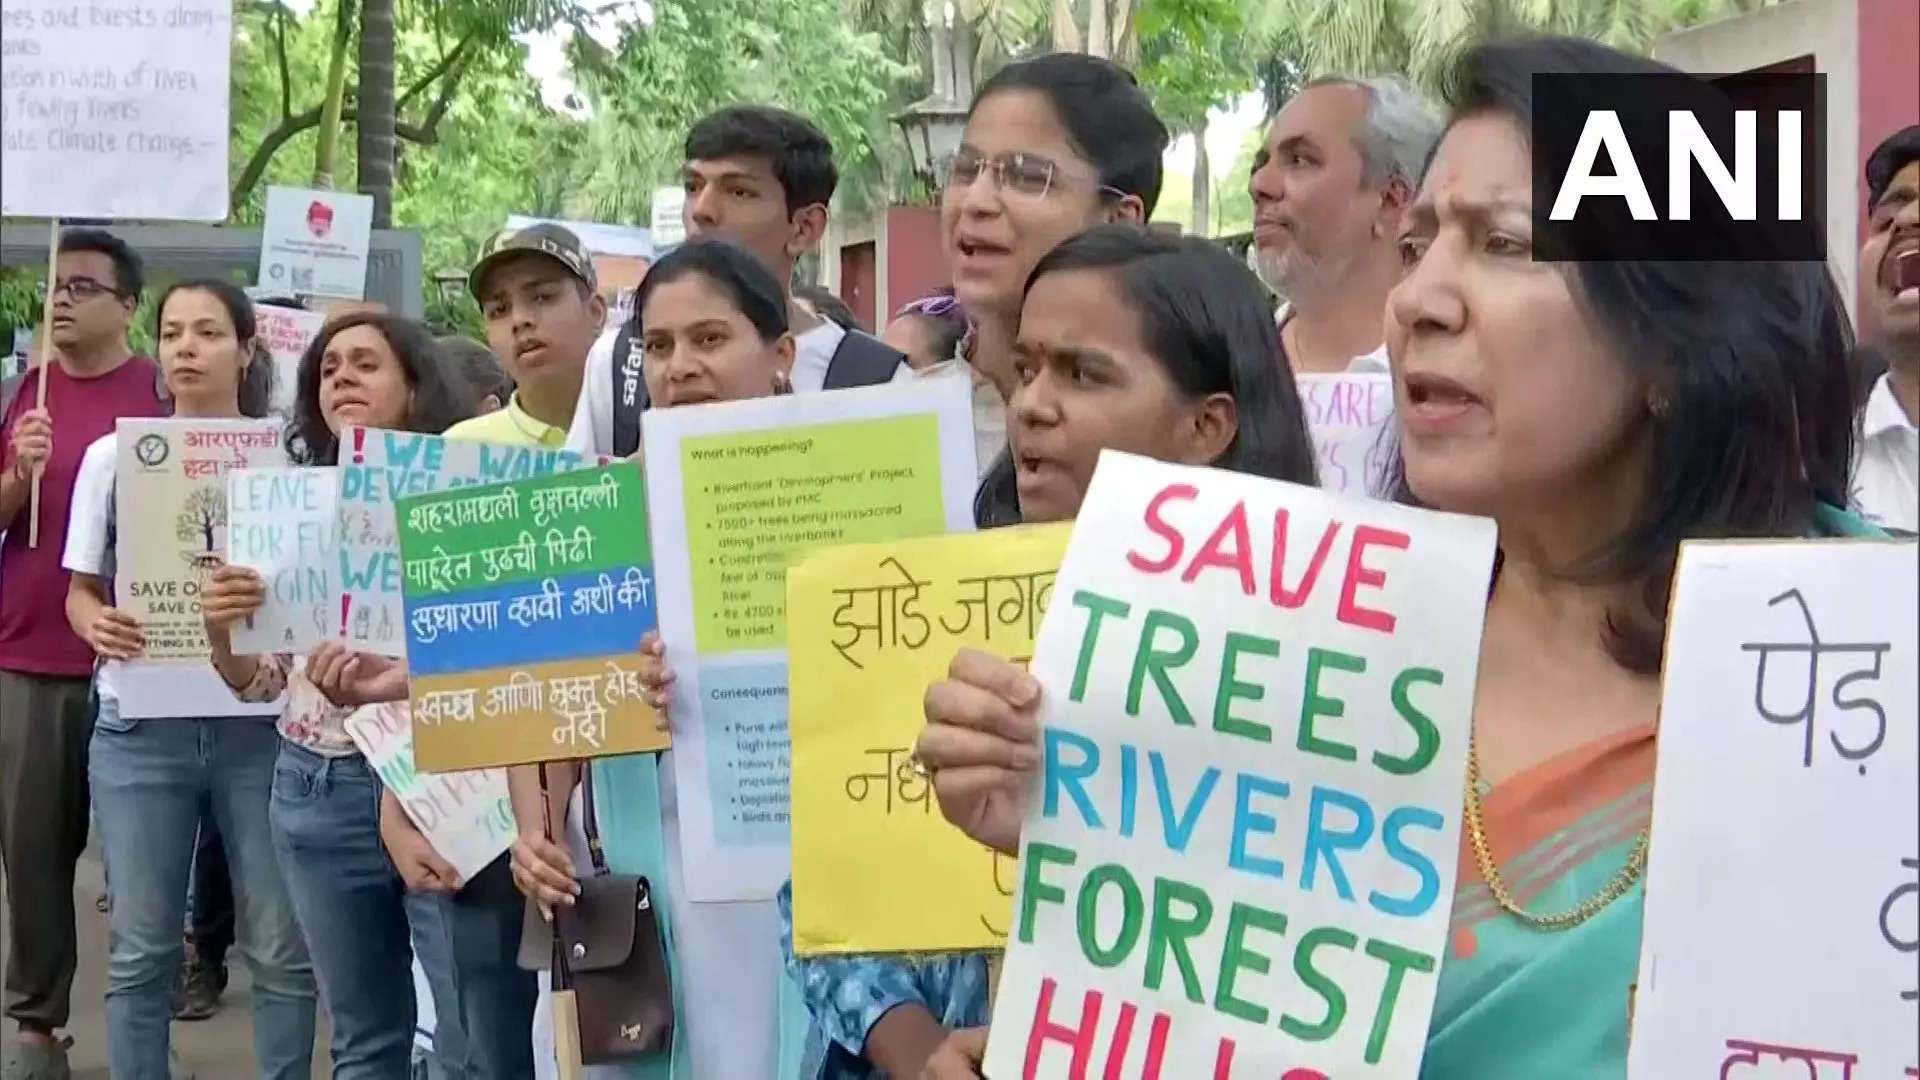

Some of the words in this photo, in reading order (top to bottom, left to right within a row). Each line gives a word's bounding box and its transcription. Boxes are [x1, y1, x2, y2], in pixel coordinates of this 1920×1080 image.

[231, 472, 321, 512] LEAVE
[385, 432, 446, 472] WE
[479, 442, 583, 477] WANT
[691, 447, 724, 460] What
[130, 581, 177, 597] SAVE
[339, 550, 400, 593] WE
[1126, 484, 1411, 634] SAVE
[148, 602, 185, 615] SAVE
[831, 557, 933, 669] झाडे
[1069, 591, 1444, 776] TREES
[1742, 588, 1891, 775] पेड़
[1042, 727, 1444, 918] RIVERS
[1018, 843, 1435, 1065] FOREST
